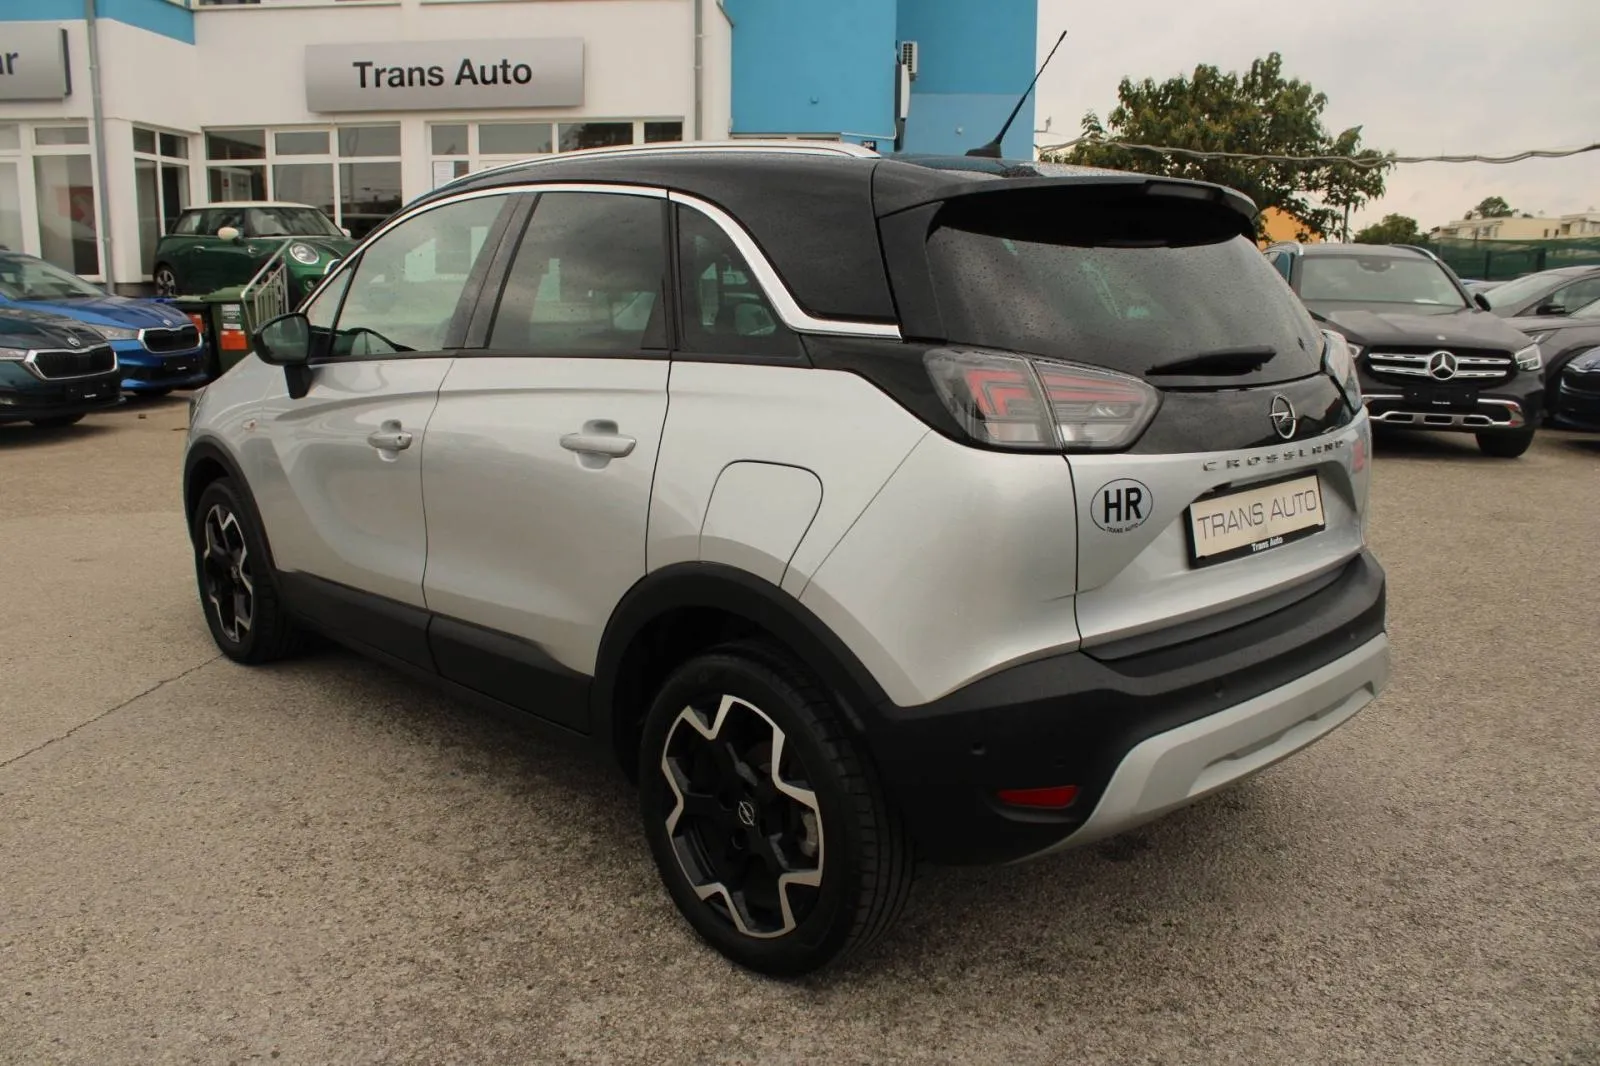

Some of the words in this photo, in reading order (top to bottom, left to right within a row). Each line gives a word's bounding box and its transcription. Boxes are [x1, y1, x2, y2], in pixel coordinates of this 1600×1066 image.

[0, 52, 19, 75] r
[353, 61, 444, 88] Trans
[454, 58, 533, 86] Auto
[1104, 487, 1142, 523] HR
[1197, 502, 1264, 540] TRANS
[1270, 489, 1317, 523] AUTO
[1251, 540, 1269, 552] Trans
[1270, 536, 1283, 547] Auto
